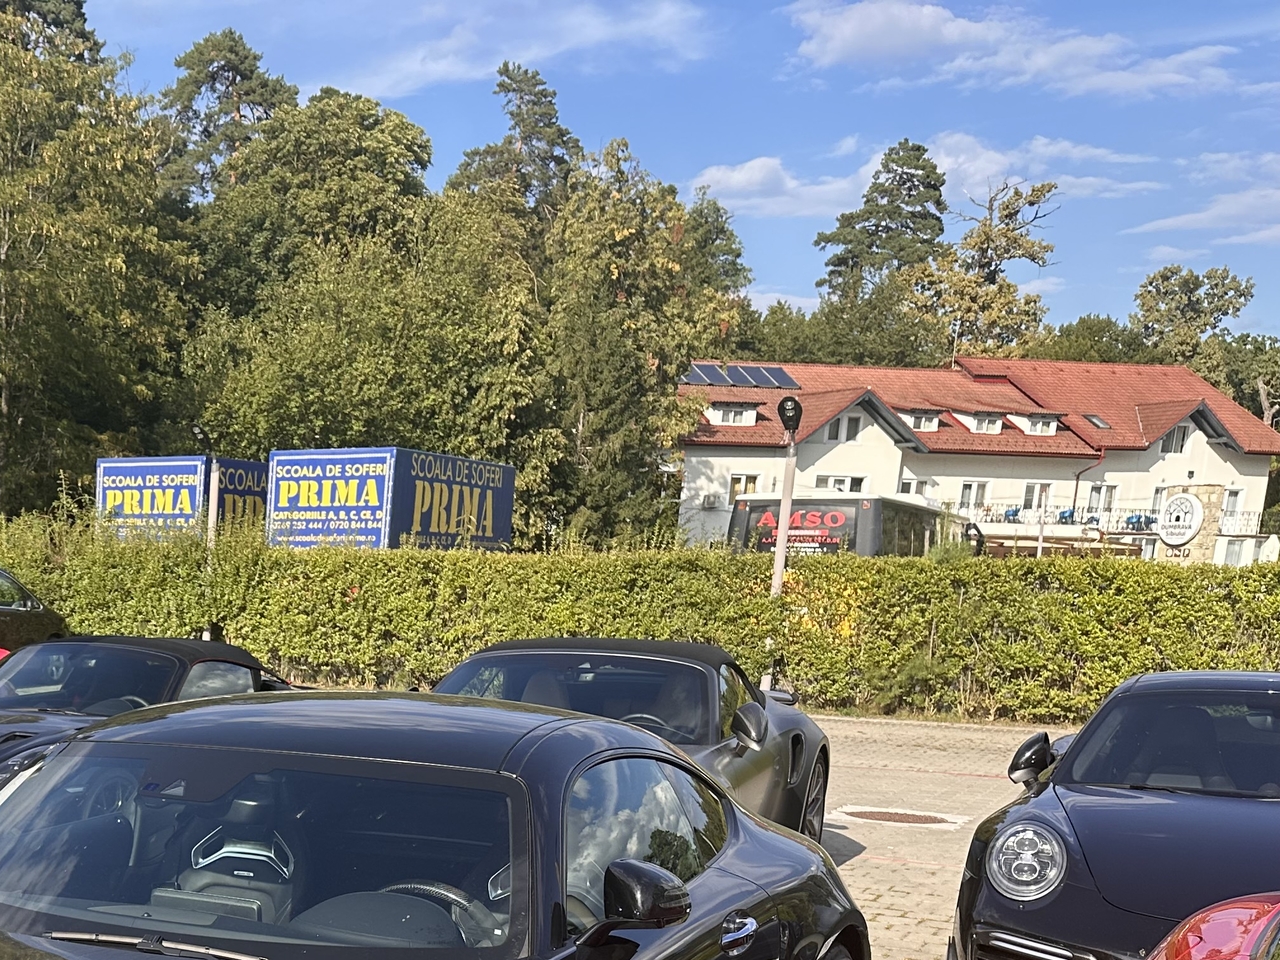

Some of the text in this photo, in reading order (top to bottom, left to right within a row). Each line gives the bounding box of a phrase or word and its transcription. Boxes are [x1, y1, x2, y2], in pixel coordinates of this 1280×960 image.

[104, 474, 197, 487] SCOALA DE SOFERI
[219, 466, 268, 491] SCOALA
[277, 463, 387, 478] SCOALA DE SOFERI
[411, 453, 503, 488] SCOALA DE SOFERI
[105, 489, 193, 515] PRIMA
[278, 479, 380, 507] PRIMA
[328, 511, 337, 520] A,
[339, 511, 347, 519] B,
[350, 511, 358, 520] C,
[360, 511, 373, 519] CE,
[376, 511, 383, 519] D
[411, 480, 494, 537] PRIMA
[324, 521, 328, 529] /
[330, 521, 349, 529] 0720
